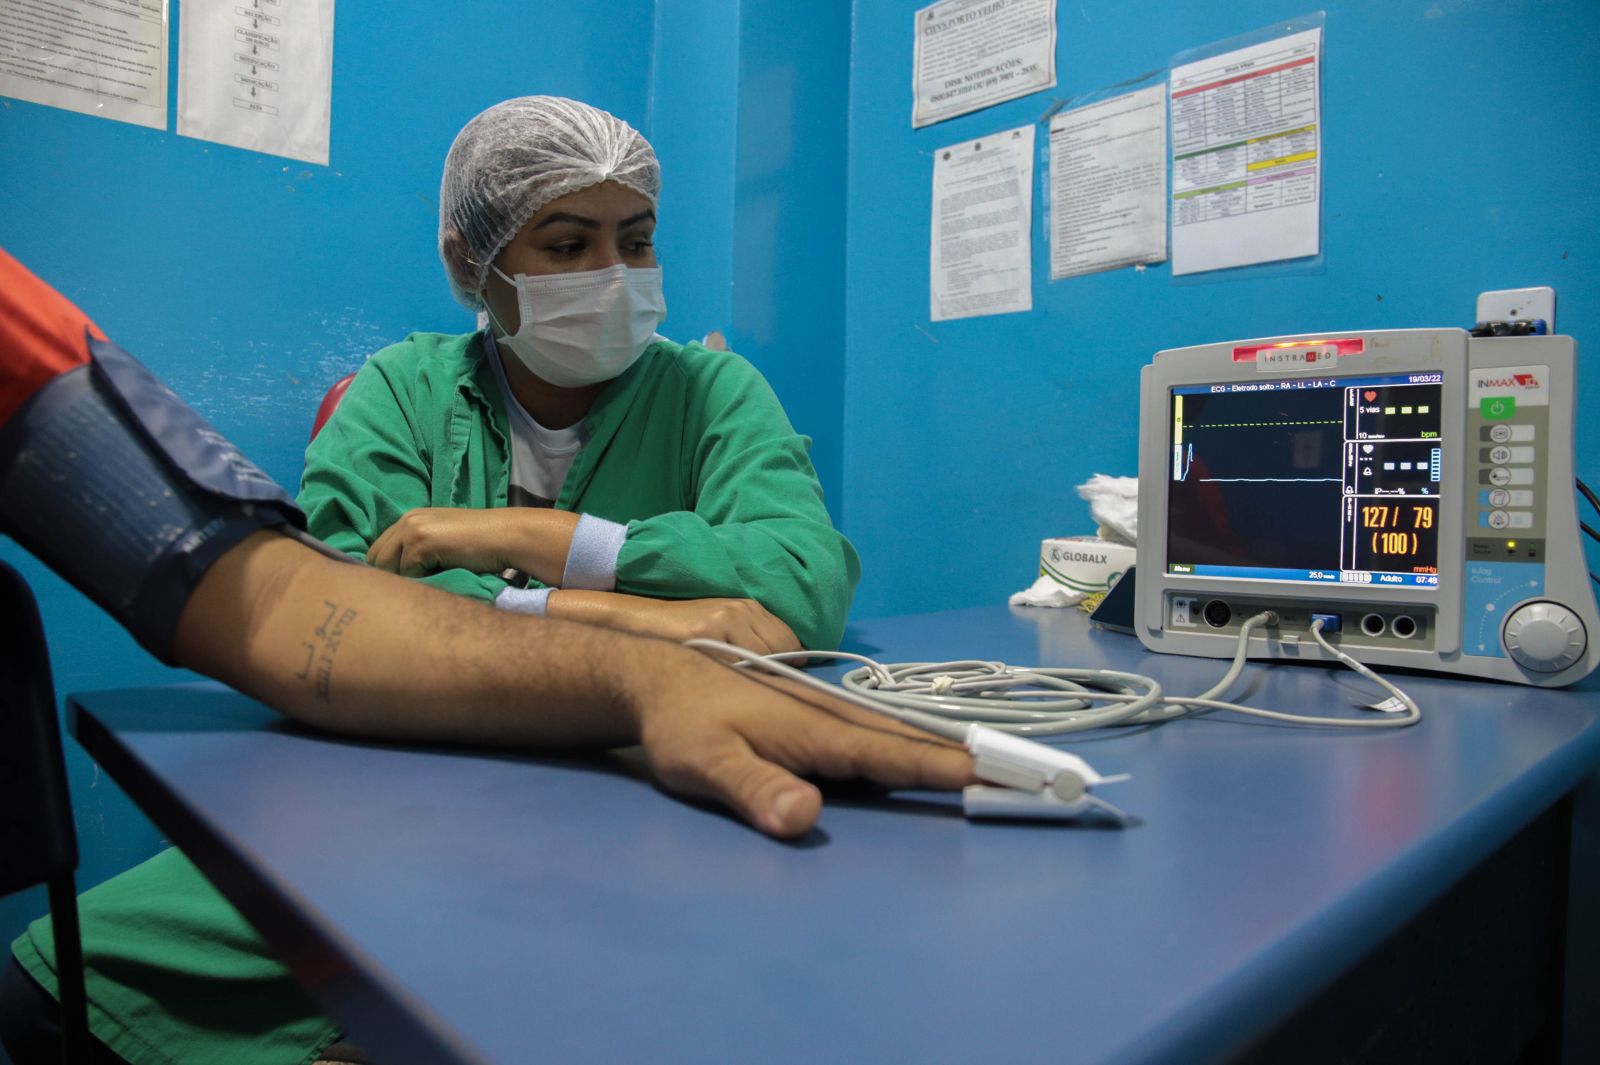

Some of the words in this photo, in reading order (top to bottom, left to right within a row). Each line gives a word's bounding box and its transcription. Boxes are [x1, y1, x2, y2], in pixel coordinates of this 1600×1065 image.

[948, 12, 976, 28] PORTO
[1264, 351, 1331, 363] INSTRAMED
[1409, 375, 1441, 383] 19/03/22
[1477, 377, 1516, 388] INMAX
[1211, 385, 1226, 393] ECG
[1232, 384, 1258, 392] Eletrodo
[1259, 383, 1274, 391] solto
[1421, 430, 1438, 438] bpm
[1413, 506, 1433, 528] 79
[1063, 551, 1108, 564] GLOBALX
[1413, 566, 1438, 574] mmHg
[1380, 574, 1403, 583] Adulto
[1416, 576, 1438, 584] 07:48
[1471, 576, 1502, 584] Control
